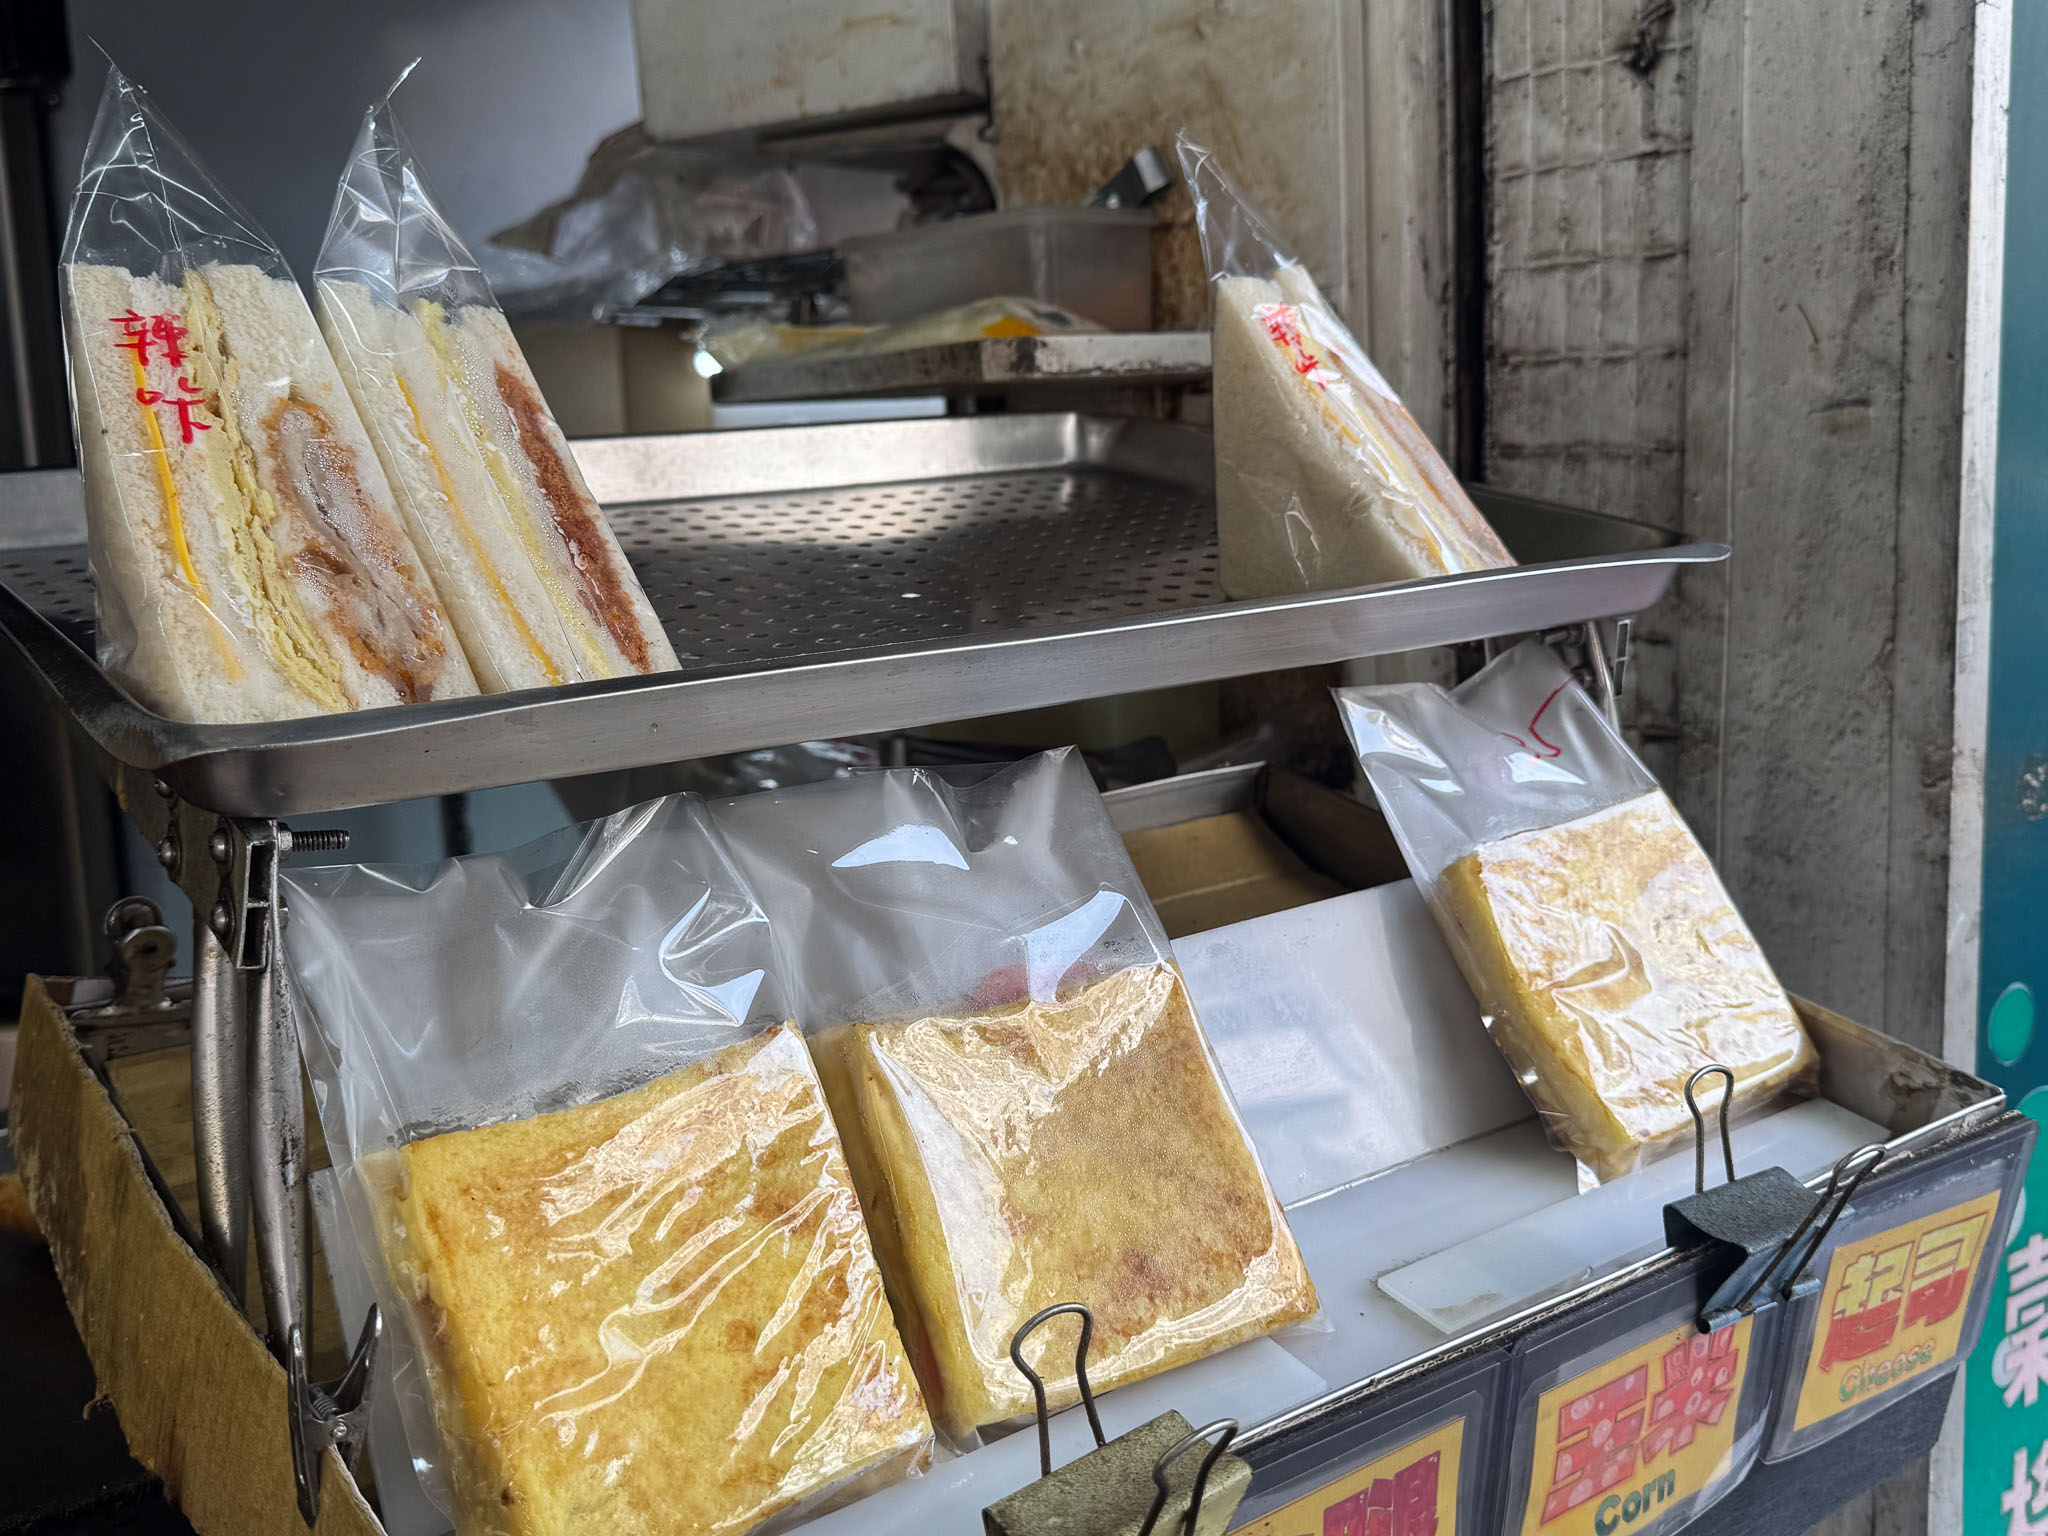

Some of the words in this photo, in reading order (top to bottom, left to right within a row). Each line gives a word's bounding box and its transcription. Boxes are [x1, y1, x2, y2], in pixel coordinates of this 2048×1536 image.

[1818, 1210, 1990, 1373] 起司
[1538, 1323, 1740, 1529] 玉米
[1838, 1337, 1937, 1402] Cheese
[1594, 1468, 1676, 1536] Corn
